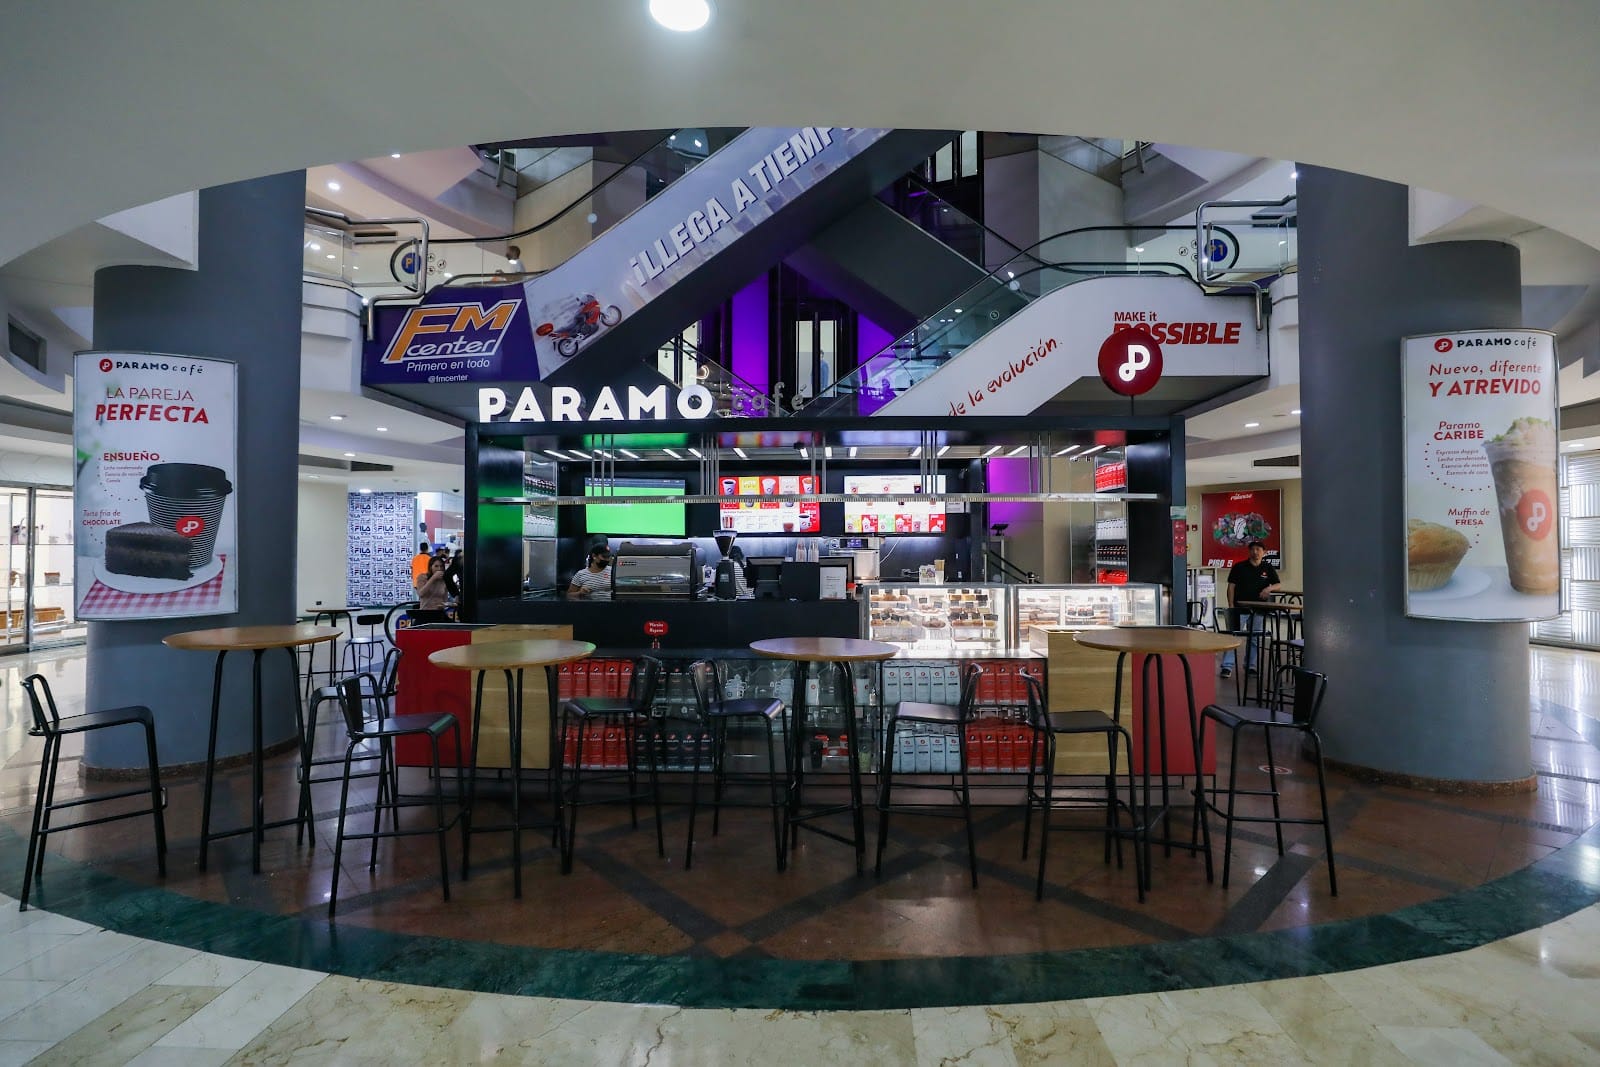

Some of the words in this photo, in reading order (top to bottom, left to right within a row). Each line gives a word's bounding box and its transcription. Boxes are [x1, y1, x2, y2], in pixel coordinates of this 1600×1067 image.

[731, 177, 759, 213] A
[748, 127, 854, 194] TIEMP
[1113, 311, 1147, 322] MAKE
[1148, 311, 1158, 322] it
[389, 303, 517, 361] FM
[406, 335, 497, 356] center
[1457, 338, 1512, 348] PARAMO
[1514, 337, 1537, 350] café
[116, 361, 169, 371] PARAMO
[172, 364, 204, 376] café
[406, 360, 448, 372] Primero
[450, 361, 464, 370] en
[466, 358, 490, 369] todo
[1429, 363, 1483, 377] Nuevo,
[1489, 360, 1543, 376] diferente
[427, 373, 469, 384] @fmcenter
[106, 386, 125, 399] LA
[129, 387, 194, 402] PAREJA
[1428, 381, 1444, 397] Y
[1446, 378, 1541, 397] ATREVIDO
[478, 384, 713, 423] PARAMO
[732, 382, 807, 418] café
[947, 400, 966, 417] de
[967, 388, 984, 407] la
[95, 403, 209, 424] PERFECTA
[1438, 421, 1480, 430] Paramo
[1433, 430, 1484, 441] CARIBE
[103, 450, 160, 461] ENSUEÑO
[112, 509, 121, 517] de
[1447, 507, 1478, 518] Muffin
[1479, 508, 1490, 516] de
[1455, 518, 1484, 526] FRESA
